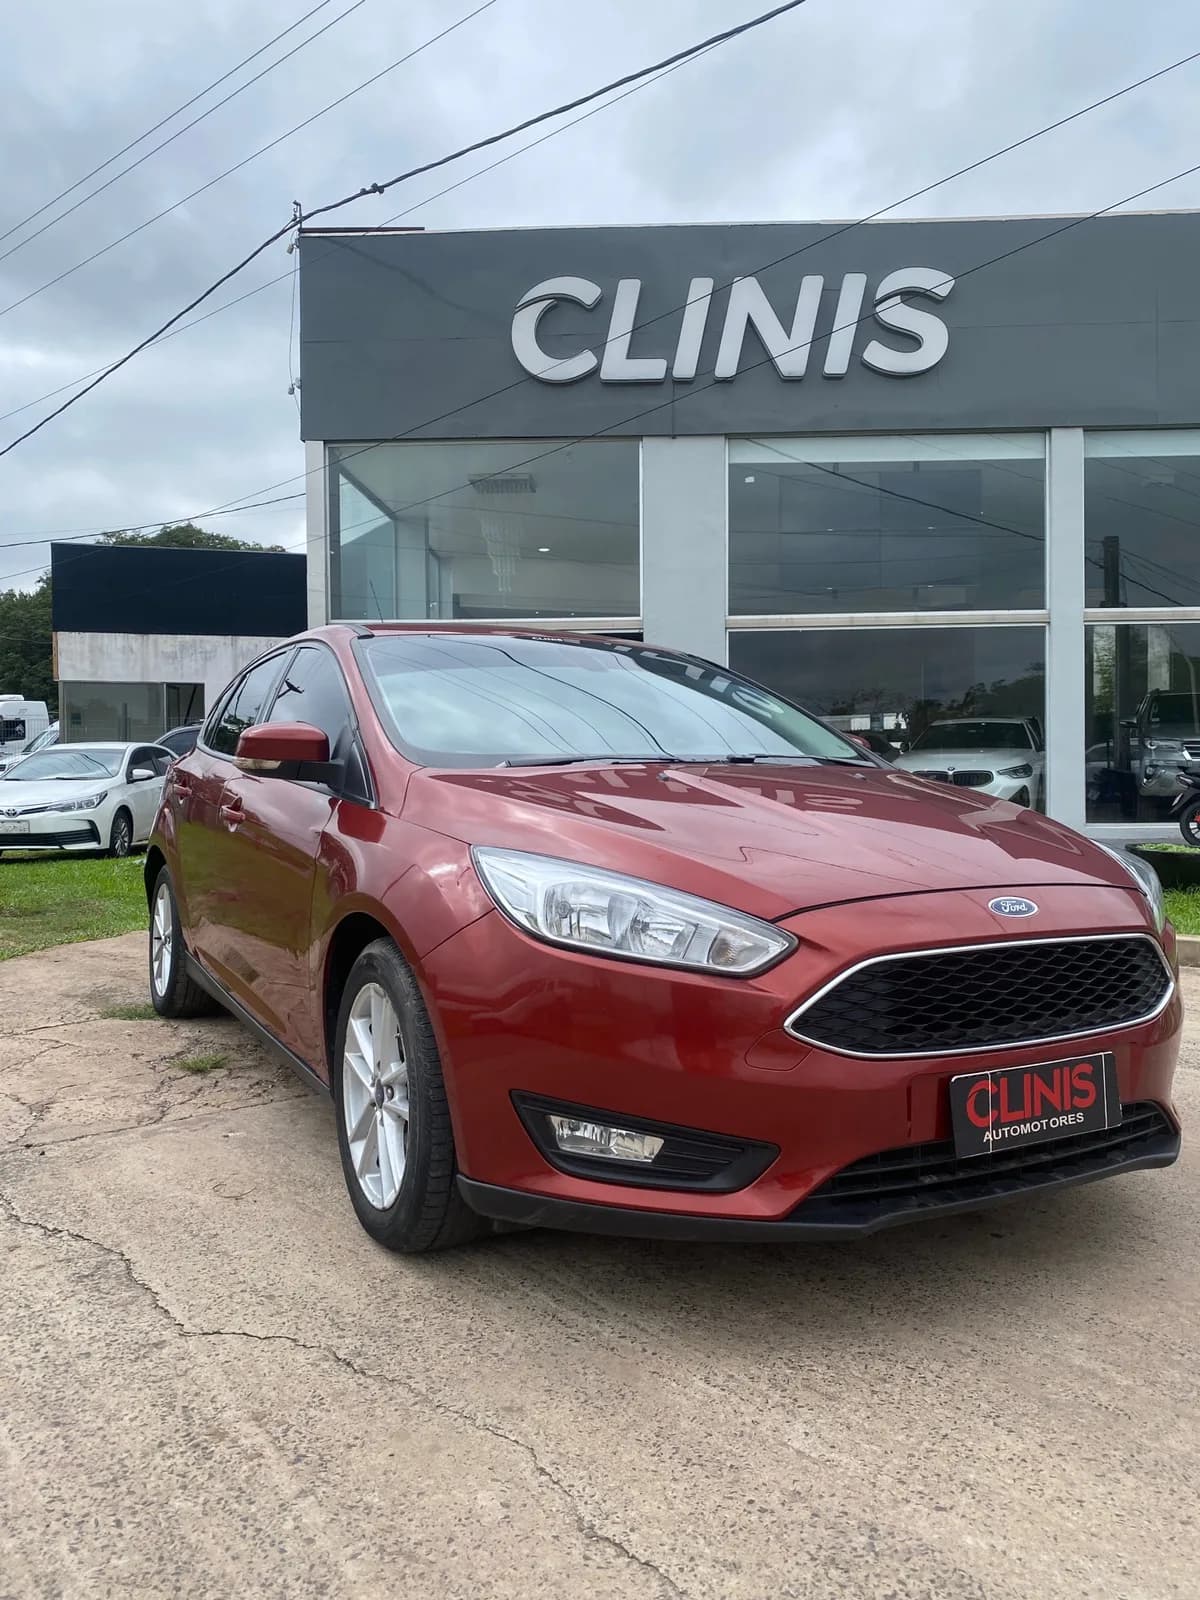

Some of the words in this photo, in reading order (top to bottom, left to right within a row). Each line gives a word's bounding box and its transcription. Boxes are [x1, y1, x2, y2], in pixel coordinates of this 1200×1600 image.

[511, 267, 955, 383] CLINIS
[1000, 900, 1028, 913] Ford
[966, 1063, 1097, 1128] CLINIS
[983, 1112, 1085, 1142] AUTOMOTORES
